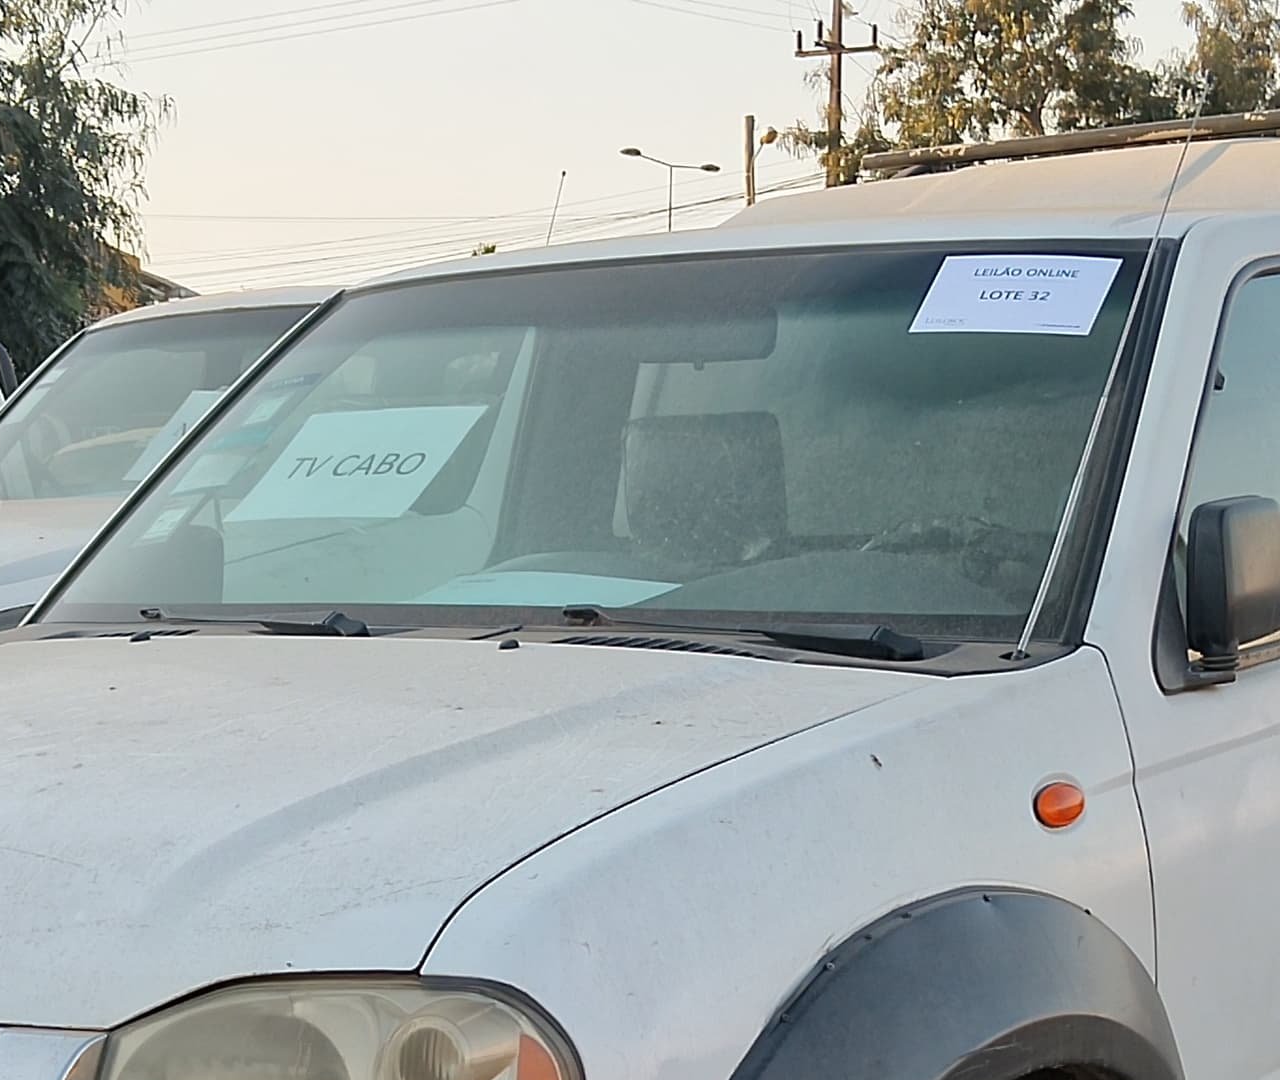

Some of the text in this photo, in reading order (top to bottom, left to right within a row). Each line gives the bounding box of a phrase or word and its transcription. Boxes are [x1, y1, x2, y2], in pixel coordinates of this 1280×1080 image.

[1026, 268, 1081, 279] ONLINE
[979, 290, 1052, 301] LOTE 32
[287, 452, 426, 479] TV CABO
